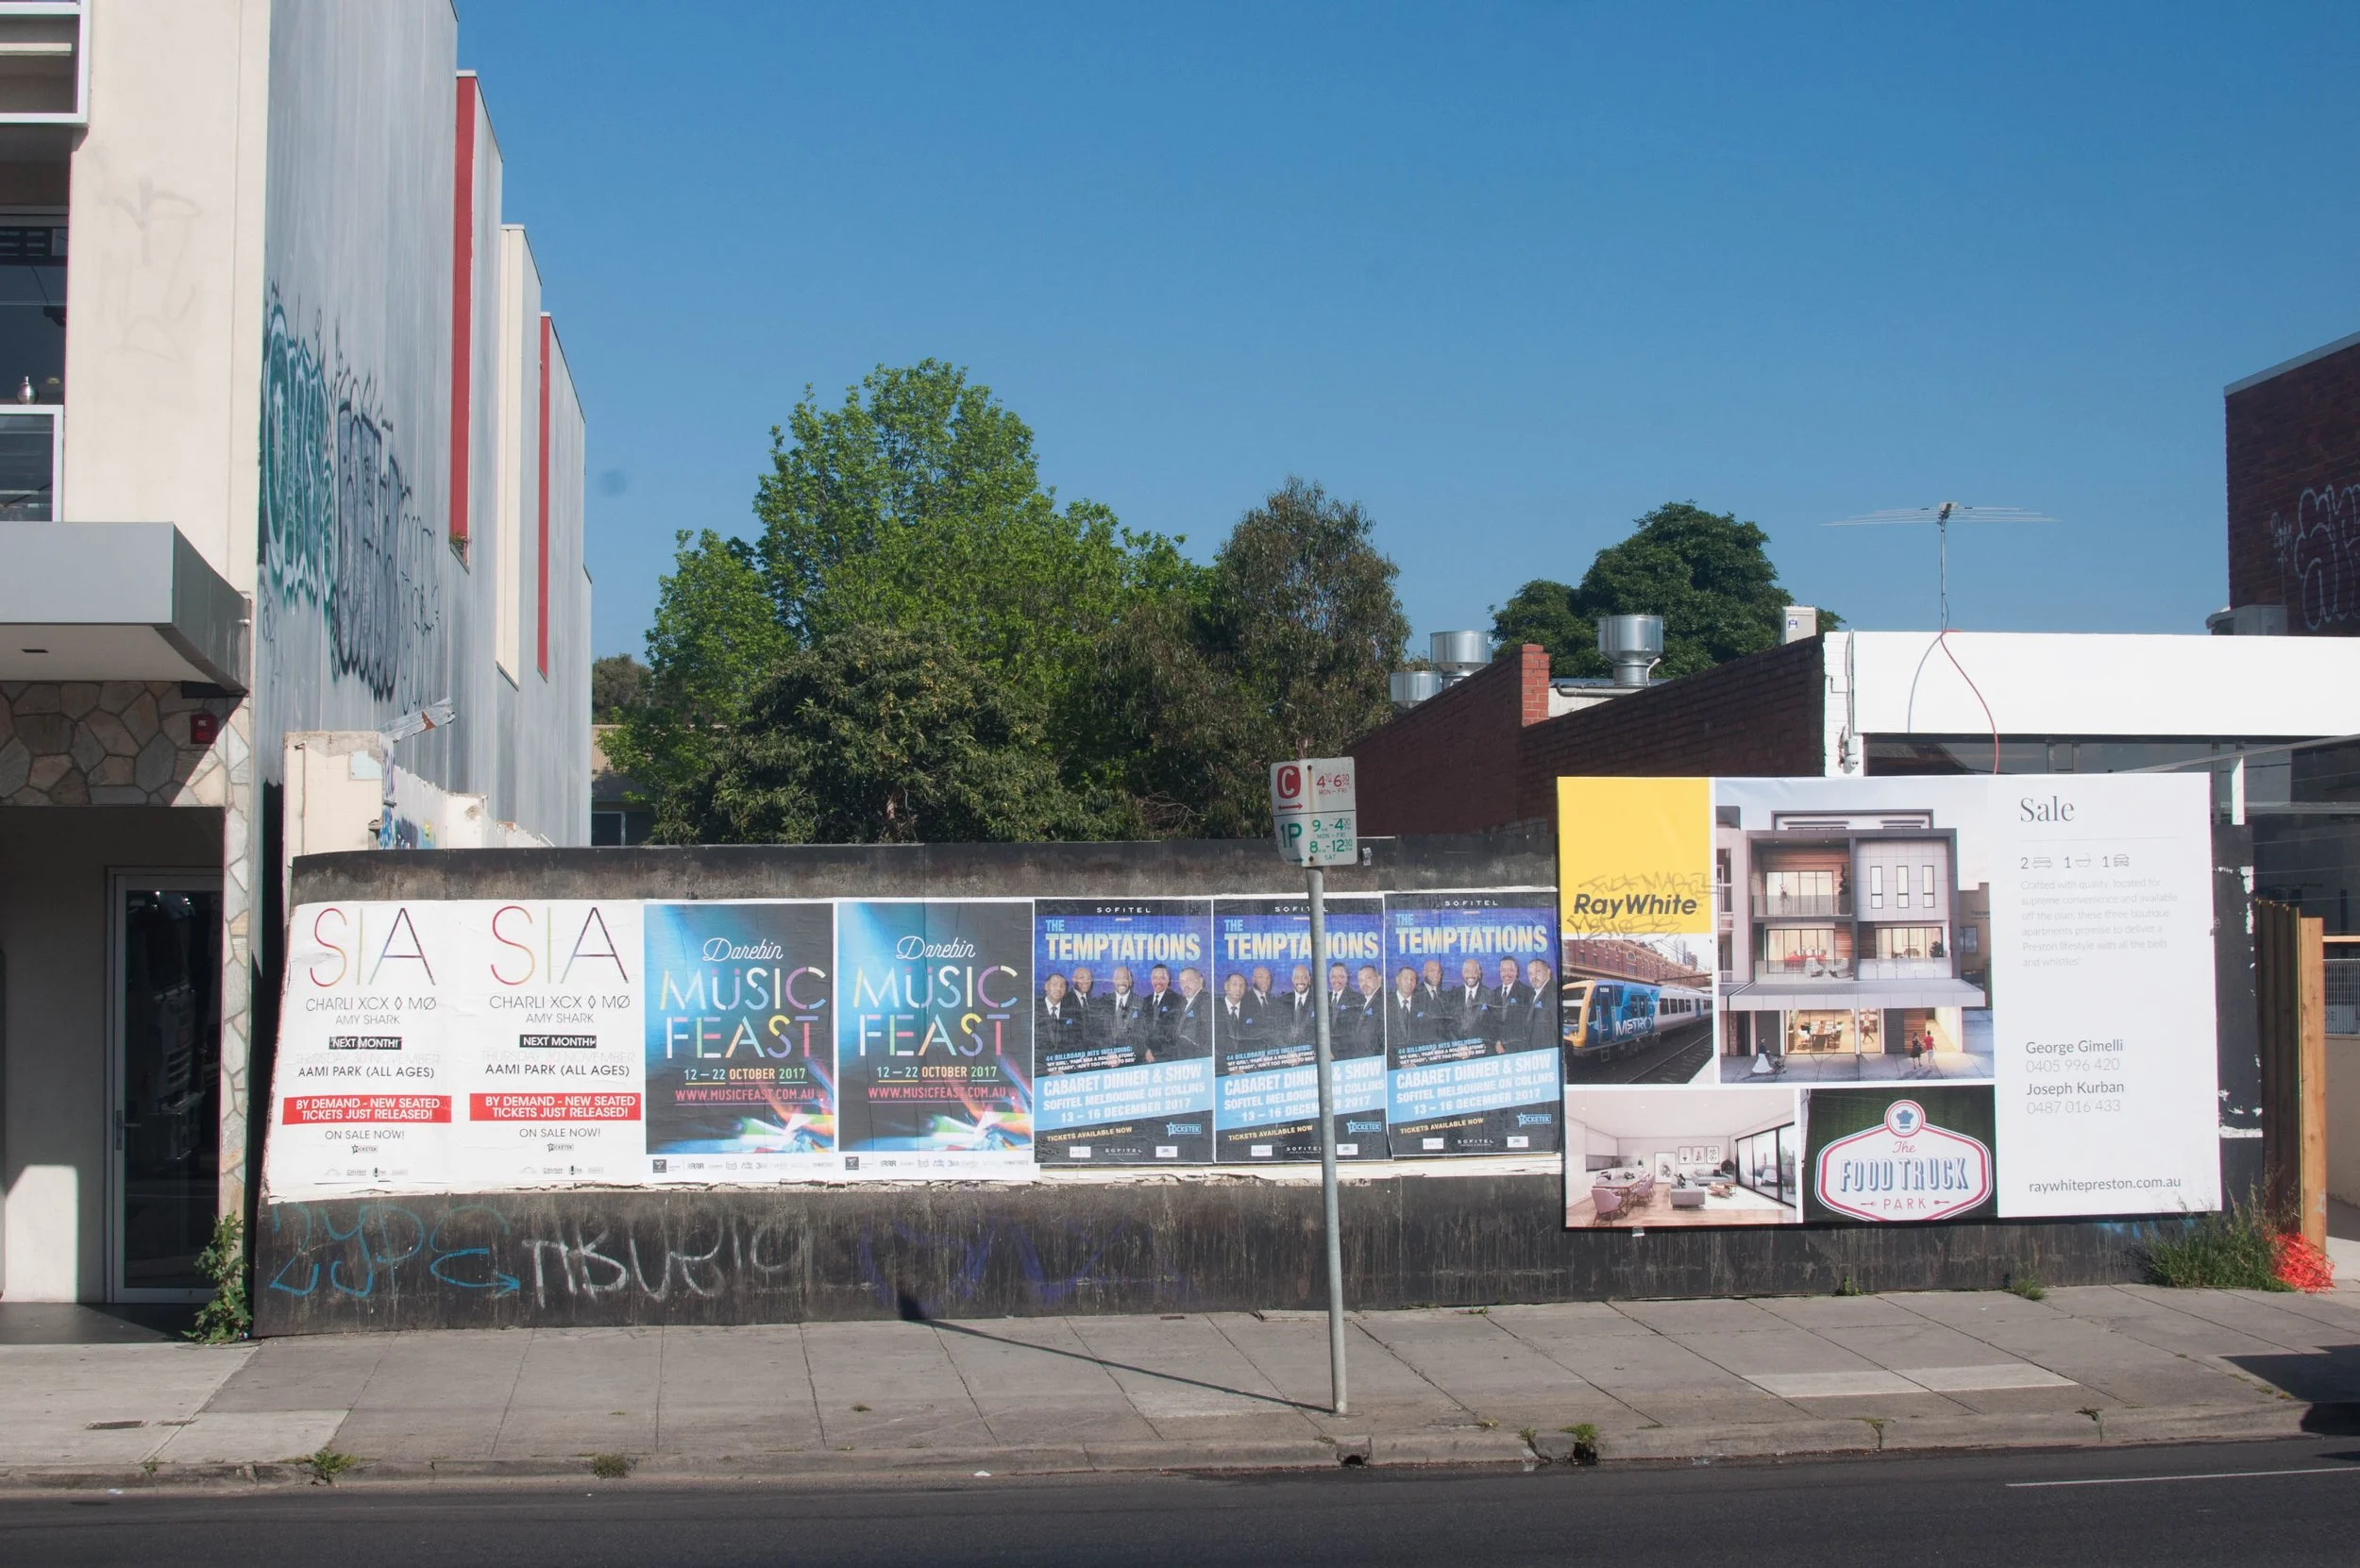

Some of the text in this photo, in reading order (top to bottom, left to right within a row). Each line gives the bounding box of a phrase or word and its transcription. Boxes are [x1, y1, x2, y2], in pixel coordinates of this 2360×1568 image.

[2020, 796, 2075, 823] Sale
[1280, 823, 1302, 848] 1P
[2020, 856, 2110, 869] 2 1 1
[2021, 897, 2061, 907] supreme
[2120, 894, 2137, 903] and
[1045, 919, 1065, 932] THE
[1224, 919, 1243, 932] THE
[1395, 914, 1414, 926] THE
[2022, 927, 2073, 937] apartments
[2075, 926, 2112, 936] promise
[491, 906, 629, 986] SIA
[1224, 932, 1379, 960] TEMPTAIONS
[1395, 925, 1548, 954] TEMPTATIONS
[310, 907, 436, 987] SIA
[702, 937, 784, 962] Darebin
[896, 936, 976, 960] Darebin
[1045, 933, 1201, 961] TEMPTATIONS
[660, 967, 827, 1010] MUSIC
[853, 965, 1018, 1008] MUSIC
[306, 997, 354, 1012] CHARLI
[357, 996, 388, 1011] XCX
[489, 995, 545, 1009] CHARLI
[548, 995, 582, 1008] XCX
[335, 1014, 400, 1026] AMY SHARK
[525, 1013, 595, 1024] AMY SHARK
[666, 1015, 818, 1058] FEAST
[859, 1012, 1010, 1056] FEAST
[332, 1037, 398, 1049] NEXT MONTH!
[523, 1037, 549, 1046] NEXT
[2026, 1039, 2123, 1055] George Gimelli
[547, 1051, 561, 1062] 30
[565, 1051, 635, 1064] NOVEMBER
[298, 1066, 435, 1078] AAMI PARK (ALL AGES)
[485, 1064, 630, 1077] AAMI PARK (ALL AGES)
[877, 1066, 997, 1077] 12 22 OCTOBER 2017
[1396, 1053, 1552, 1089] CABARET DINNER SHOW
[2026, 1058, 2120, 1072] 0405 996 420
[684, 1068, 806, 1080] 12 22 OCTOBER 2017
[1044, 1063, 1202, 1096] CABARET DINNER & SHOW
[1224, 1061, 1381, 1096] CABARET SHOW
[675, 1088, 815, 1101] WWW.MUSICFEAST.COM.AU
[868, 1087, 1006, 1099] WWW.MUSICFEAST.COM.AU
[1396, 1071, 1555, 1104] SOFITEL MELBOURNE COLLINS
[2027, 1081, 2125, 1097] Joseph Kurban
[485, 1096, 635, 1106] BY DEMAND NEW SEATED
[1043, 1082, 1205, 1111] SOFITEL MELBOURNE ON COLLINS
[1223, 1096, 1262, 1110] SOFITEL
[1456, 1088, 1541, 1110] DECEMBER 2017
[296, 1098, 440, 1110] BY DEMAND NEW SEATED
[1061, 1098, 1192, 1123] 13 16 DECEMBER 2017
[2027, 1099, 2121, 1114] 0487 016 433
[302, 1109, 433, 1121] TICKETS JUST RELEASED!
[493, 1107, 628, 1118] TICKETS JUST RELEASED!
[519, 1128, 600, 1138] ON SALE NOW!
[1400, 1118, 1484, 1135] TICKETS AVAILABLE NOW
[325, 1130, 405, 1140] ON SALE NOW!
[1047, 1133, 1076, 1142] TICKETS
[1077, 1128, 1115, 1139] AVAILABLE
[1228, 1132, 1257, 1141] TICKETS
[1258, 1127, 1295, 1138] AVAILABLE
[1892, 1141, 1916, 1154] The
[1840, 1157, 1969, 1192] FOOD TRUCK
[2029, 1177, 2182, 1193] raywhitepreston.com.au
[1883, 1198, 1927, 1210] PARK
